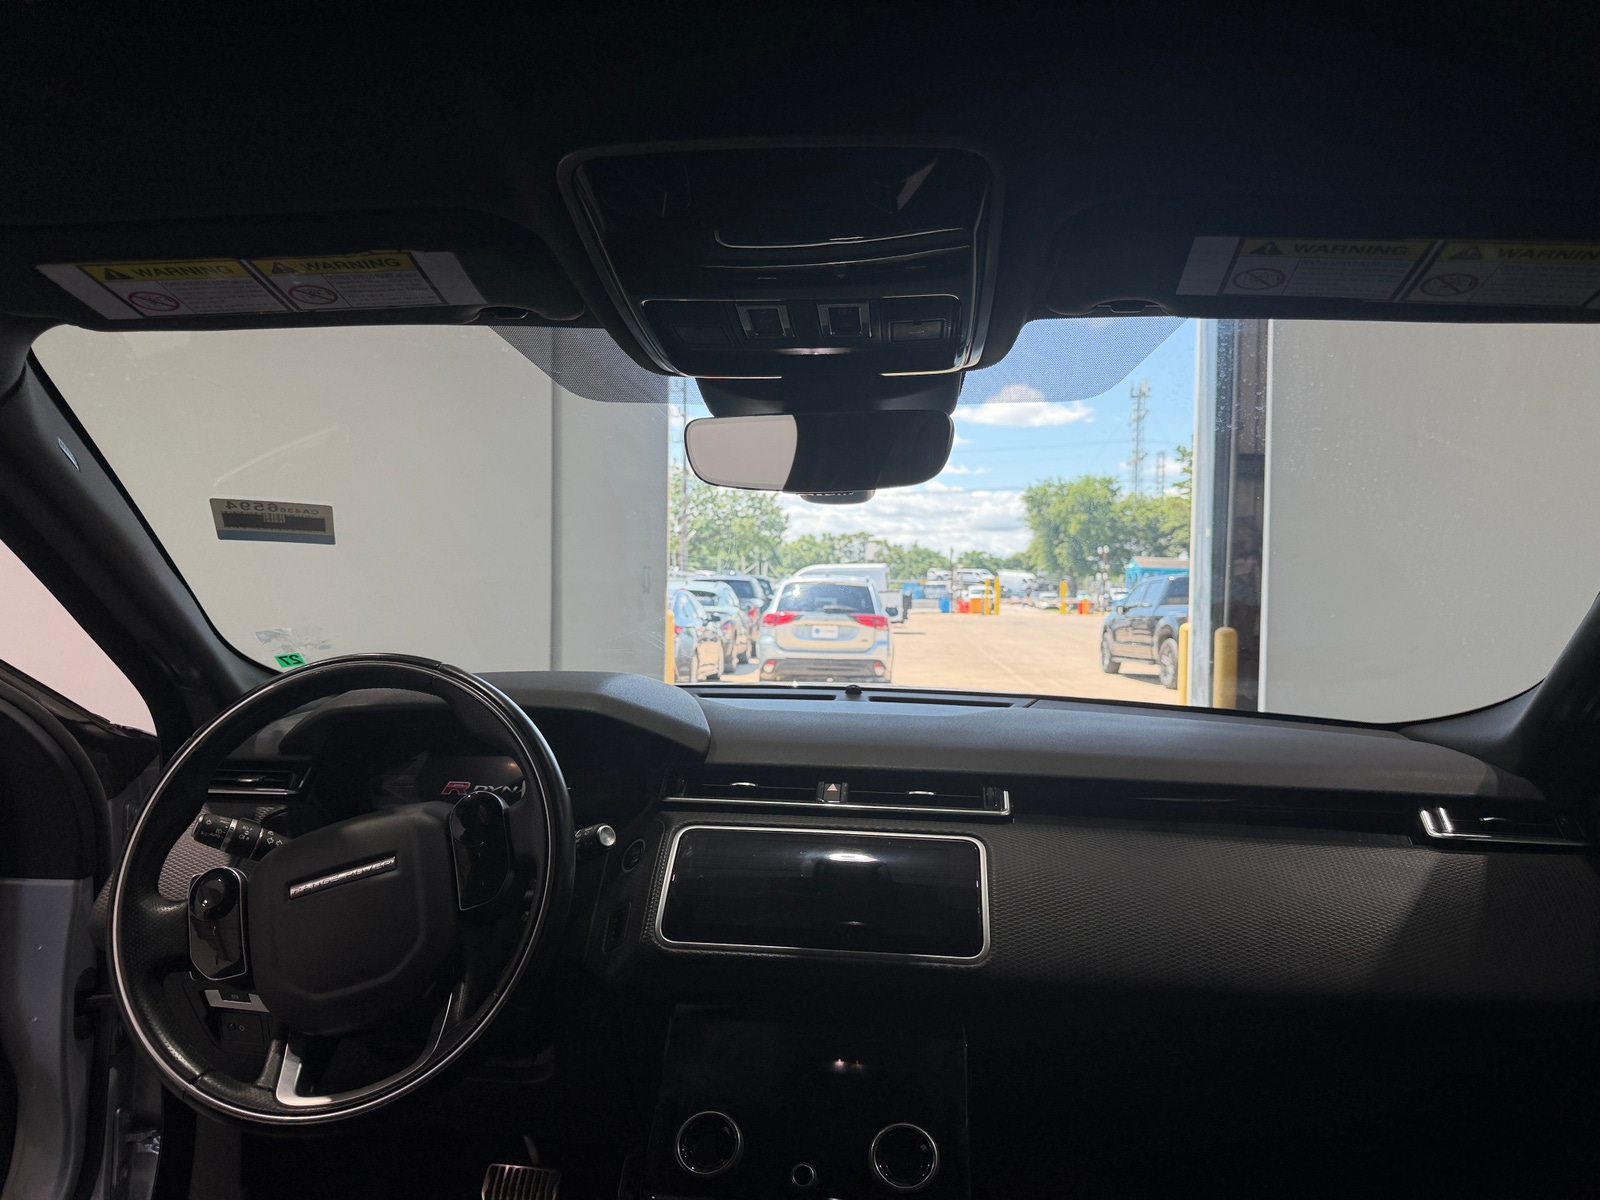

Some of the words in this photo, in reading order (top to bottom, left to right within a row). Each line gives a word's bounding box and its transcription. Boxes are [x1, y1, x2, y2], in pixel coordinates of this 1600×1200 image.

[1294, 243, 1410, 256] WARNING
[1497, 248, 1600, 261] WARNIN
[132, 265, 234, 277] WARNING
[300, 258, 402, 271] WARNING
[442, 781, 471, 796] R
